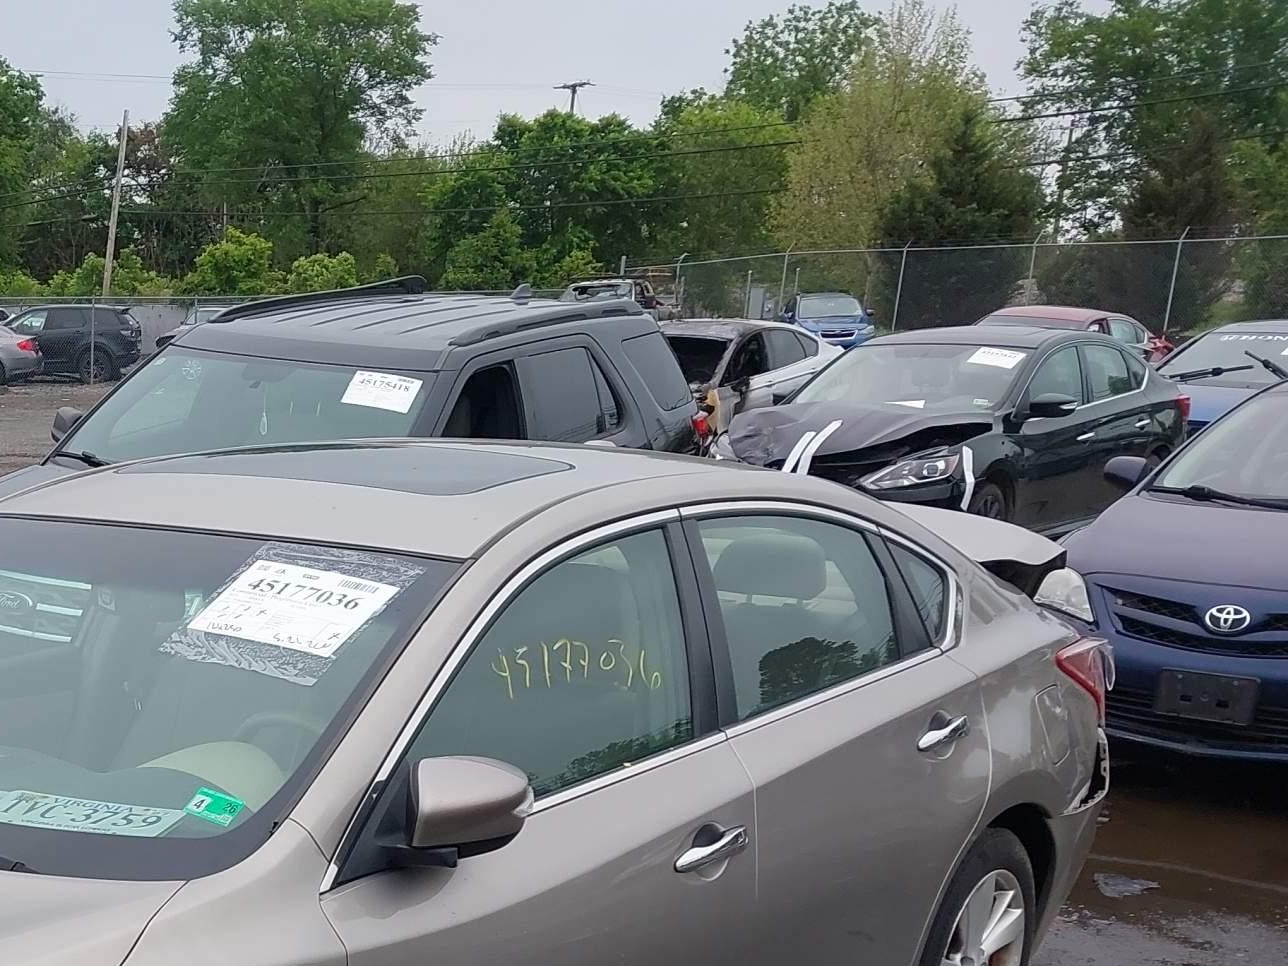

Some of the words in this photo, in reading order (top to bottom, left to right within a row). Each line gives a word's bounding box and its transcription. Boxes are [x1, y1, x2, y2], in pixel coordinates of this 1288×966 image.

[248, 578, 364, 610] 45177036
[54, 797, 133, 812] VIRGINIA
[194, 799, 206, 810] 4
[223, 802, 239, 814] 26
[0, 798, 162, 829] TVC-3759
